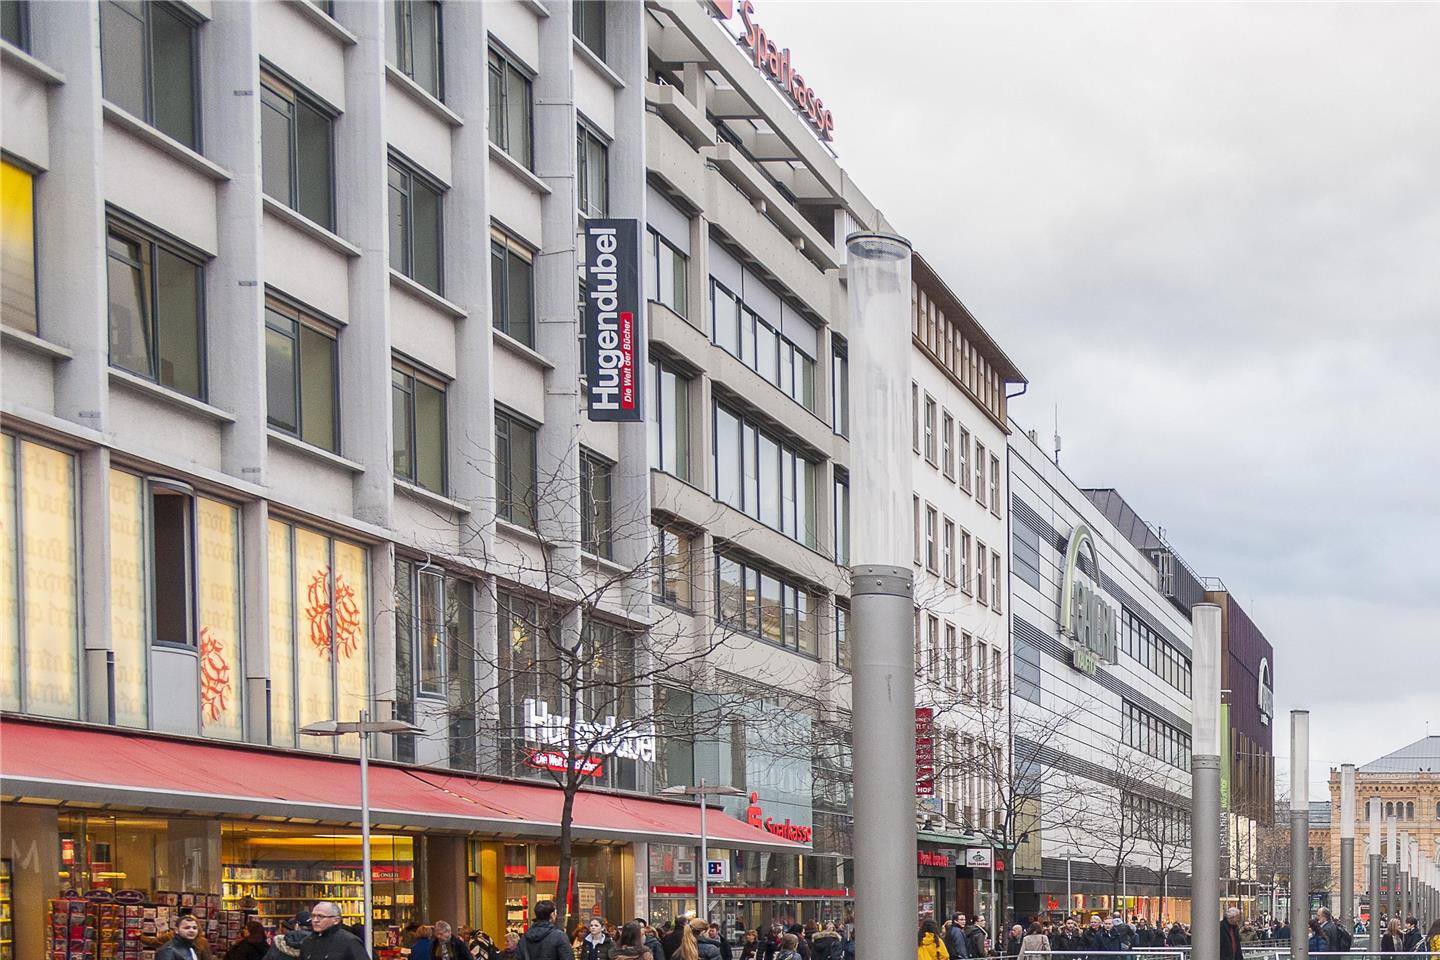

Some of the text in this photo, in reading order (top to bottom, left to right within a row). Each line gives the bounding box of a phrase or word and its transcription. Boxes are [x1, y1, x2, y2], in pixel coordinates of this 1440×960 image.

[740, 0, 834, 142] Sparkasse
[590, 228, 624, 410] Hugendubel
[624, 319, 632, 403] Die Welt der Bücher
